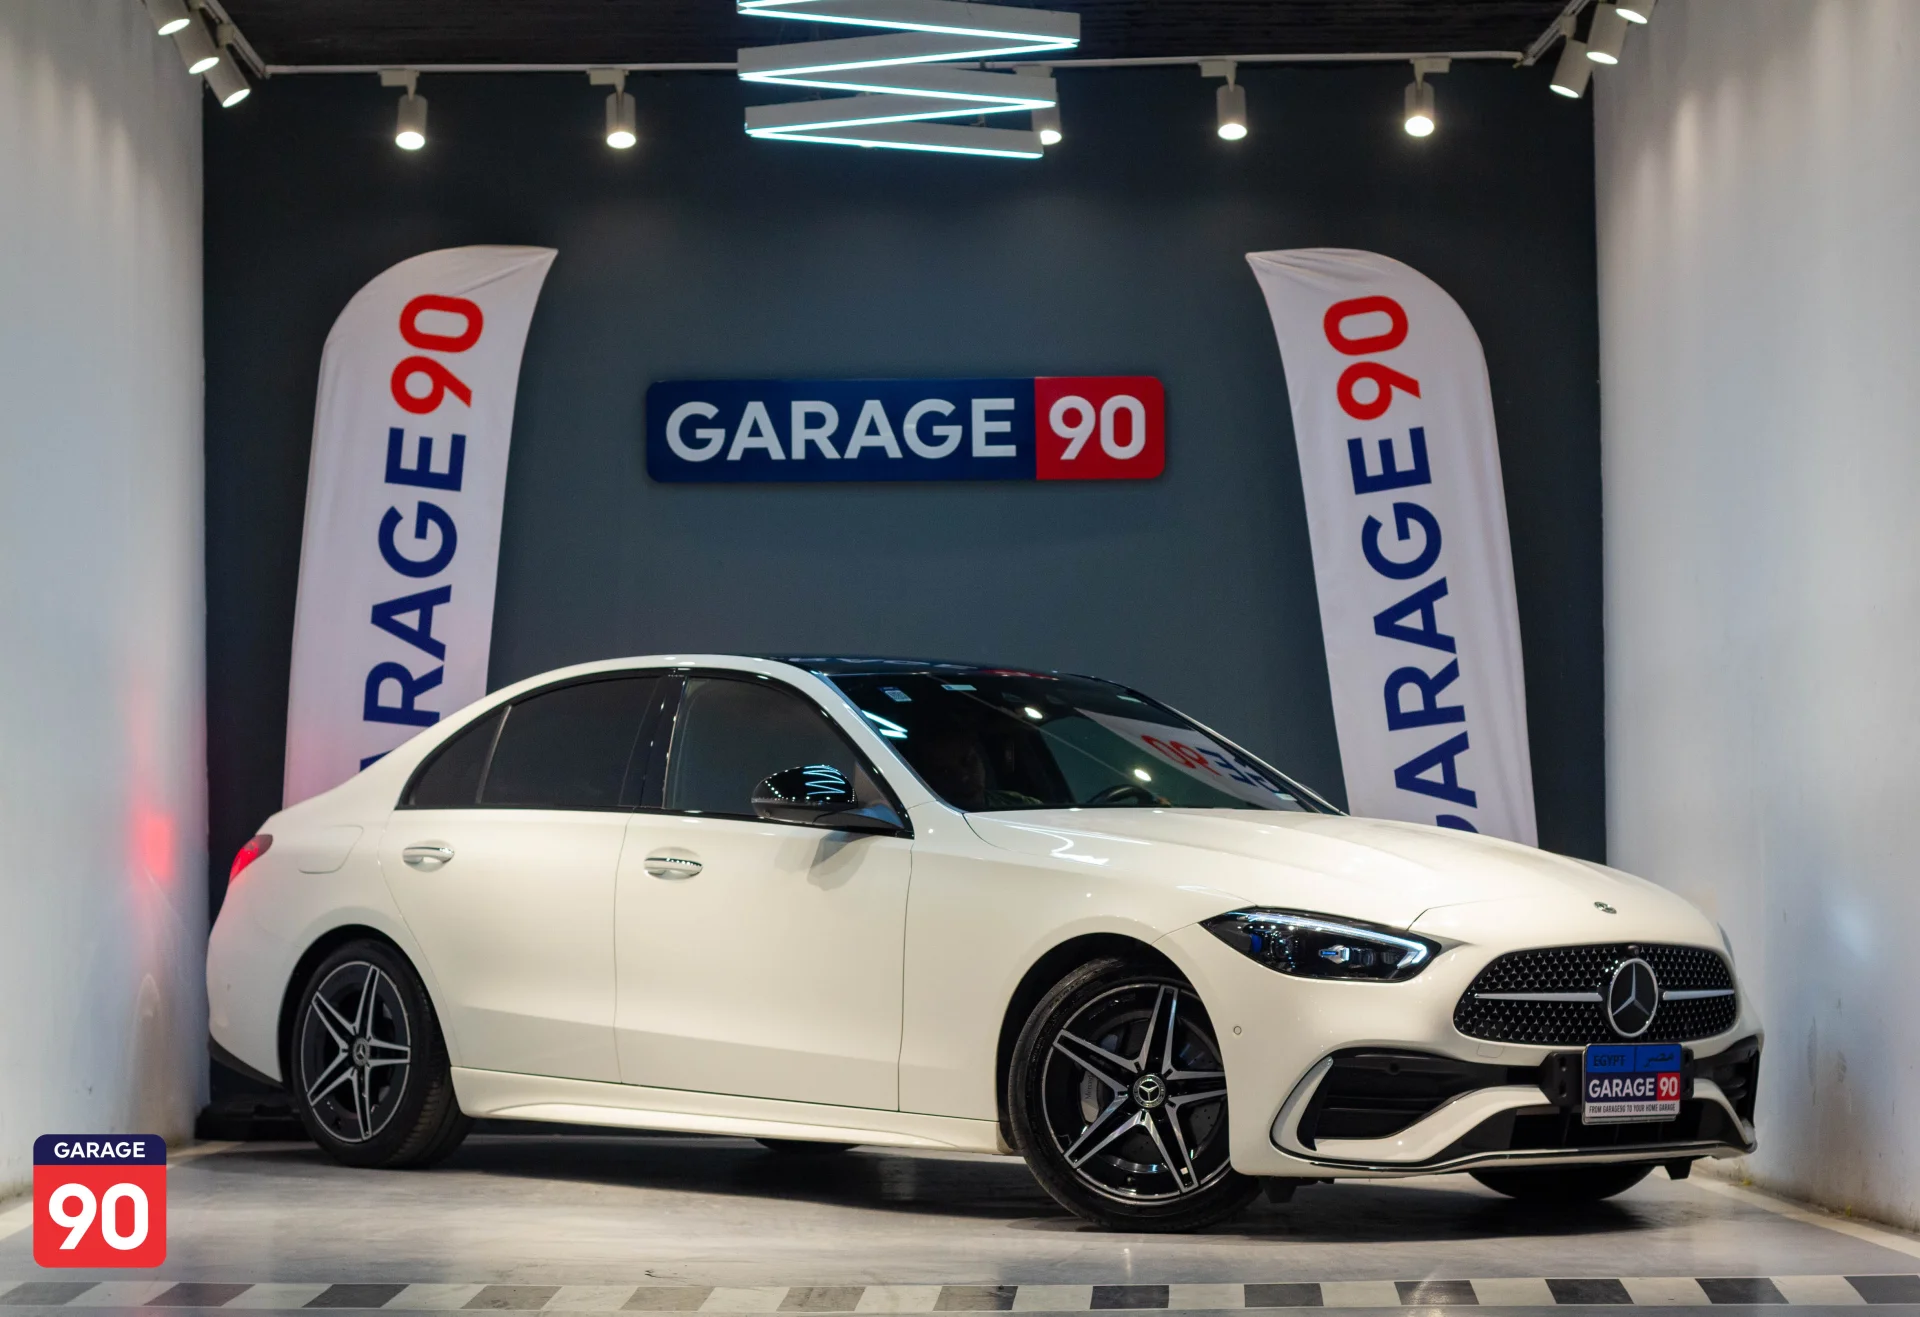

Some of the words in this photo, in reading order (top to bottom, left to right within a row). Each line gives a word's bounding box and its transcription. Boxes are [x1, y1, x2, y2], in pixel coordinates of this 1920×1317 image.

[666, 398, 1017, 462] GARAGE
[1049, 395, 1146, 460] 90
[360, 294, 484, 772] RAGE90
[1323, 295, 1479, 833] ARAGE90
[1593, 1054, 1625, 1067] EGYPT
[1588, 1078, 1655, 1098] GARAGE
[1659, 1076, 1678, 1097] 90
[1589, 1105, 1602, 1113] FROM
[1626, 1104, 1633, 1112] TO
[1633, 1104, 1645, 1112] YOUR
[1646, 1103, 1658, 1111] HOME
[1659, 1103, 1676, 1111] GARAGE
